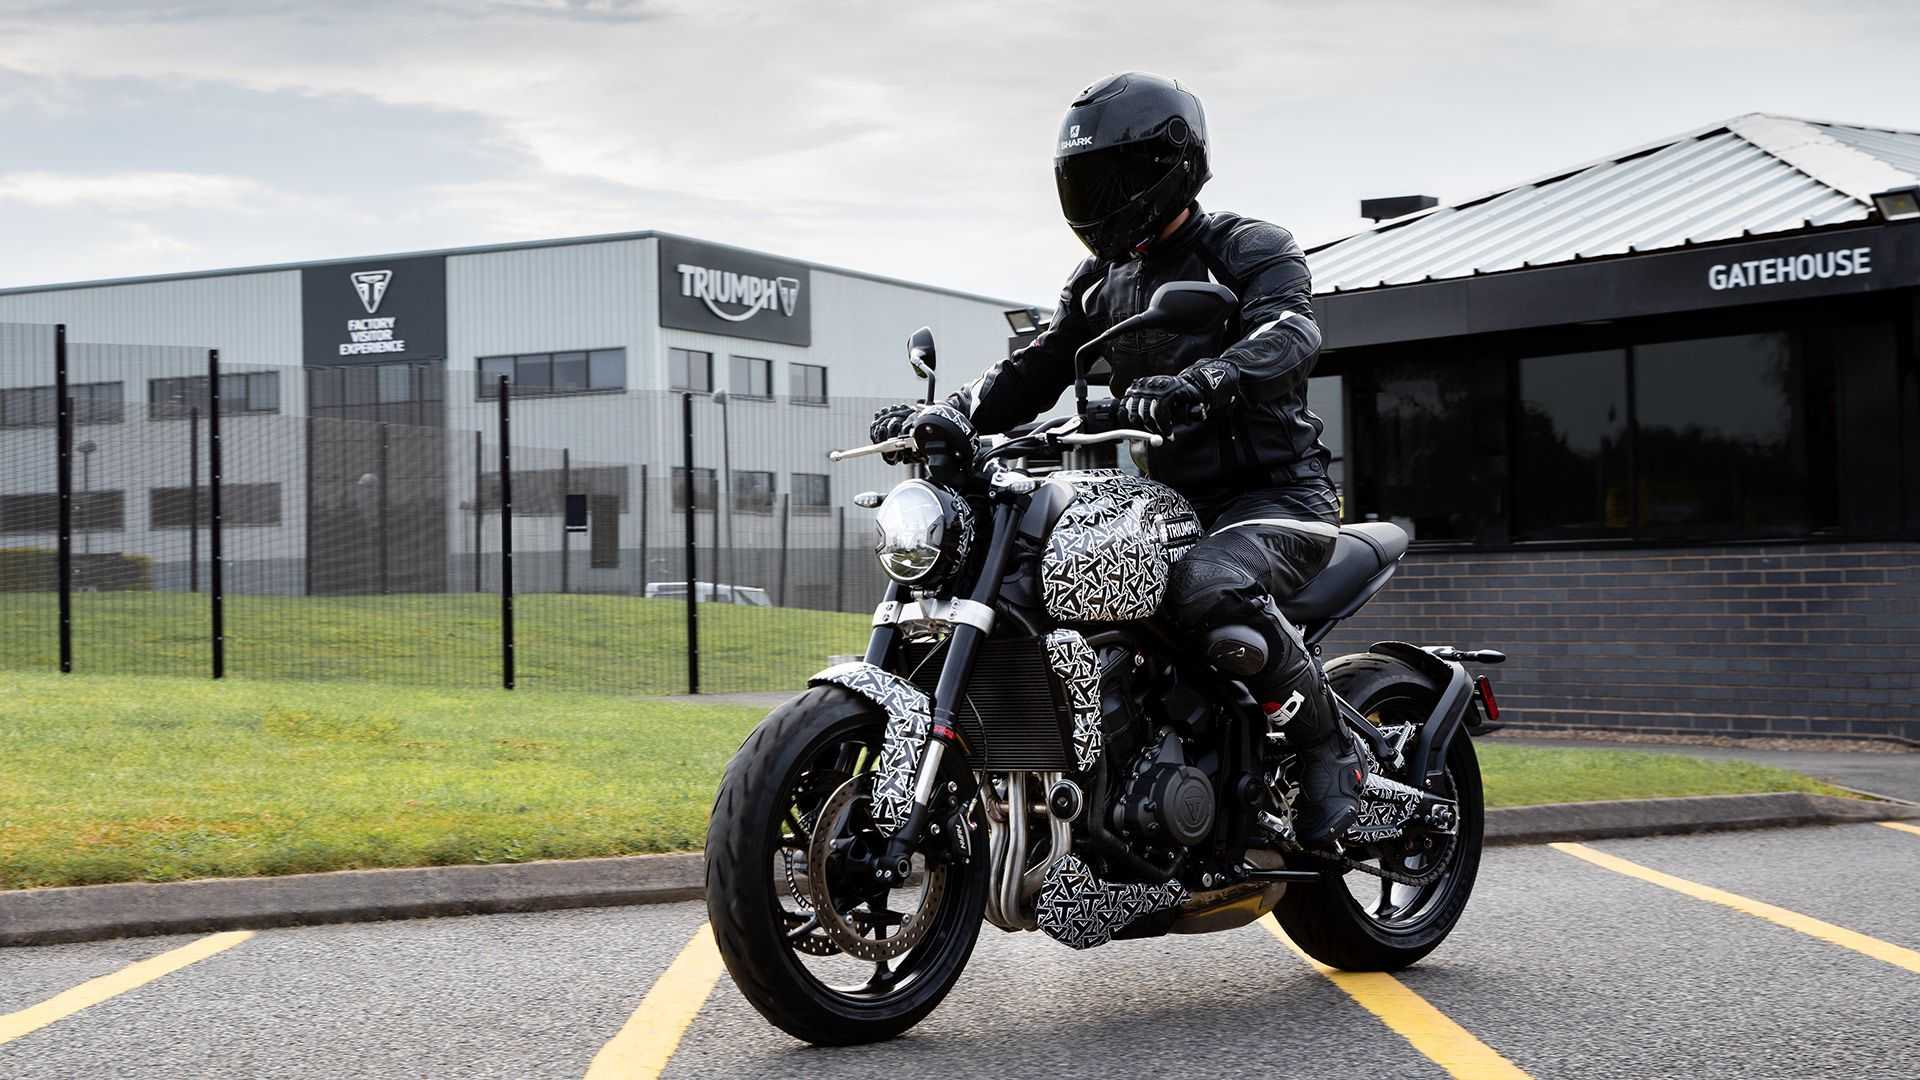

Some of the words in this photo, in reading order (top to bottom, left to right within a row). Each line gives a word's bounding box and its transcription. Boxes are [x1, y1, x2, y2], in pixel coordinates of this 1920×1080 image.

[1061, 136, 1093, 150] SHARK
[1708, 247, 1872, 290] GATEHOUSE
[677, 263, 778, 321] TRIUMPH
[347, 316, 396, 331] FACTORY
[350, 329, 393, 342] VISITOR
[339, 340, 406, 355] EXPERIENCE
